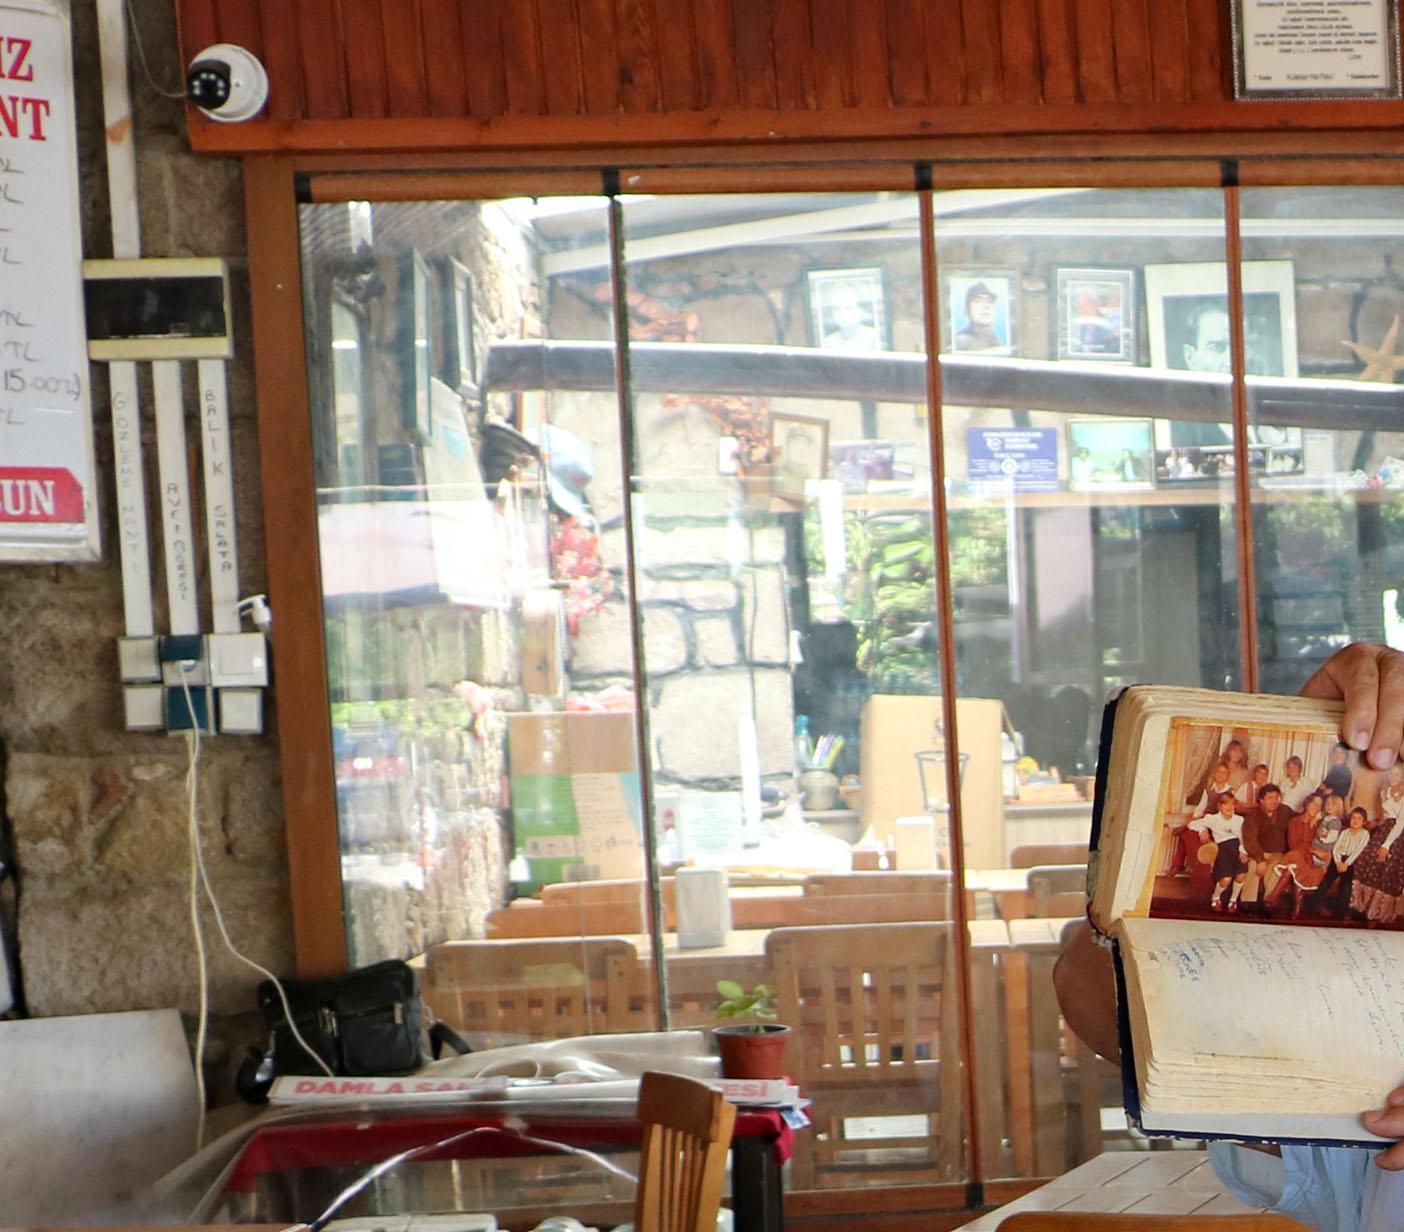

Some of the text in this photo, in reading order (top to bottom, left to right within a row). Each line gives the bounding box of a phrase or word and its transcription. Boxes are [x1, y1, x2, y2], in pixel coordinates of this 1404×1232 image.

[205, 389, 233, 573] BALIK SALATA
[295, 1080, 405, 1095] DAMLA
